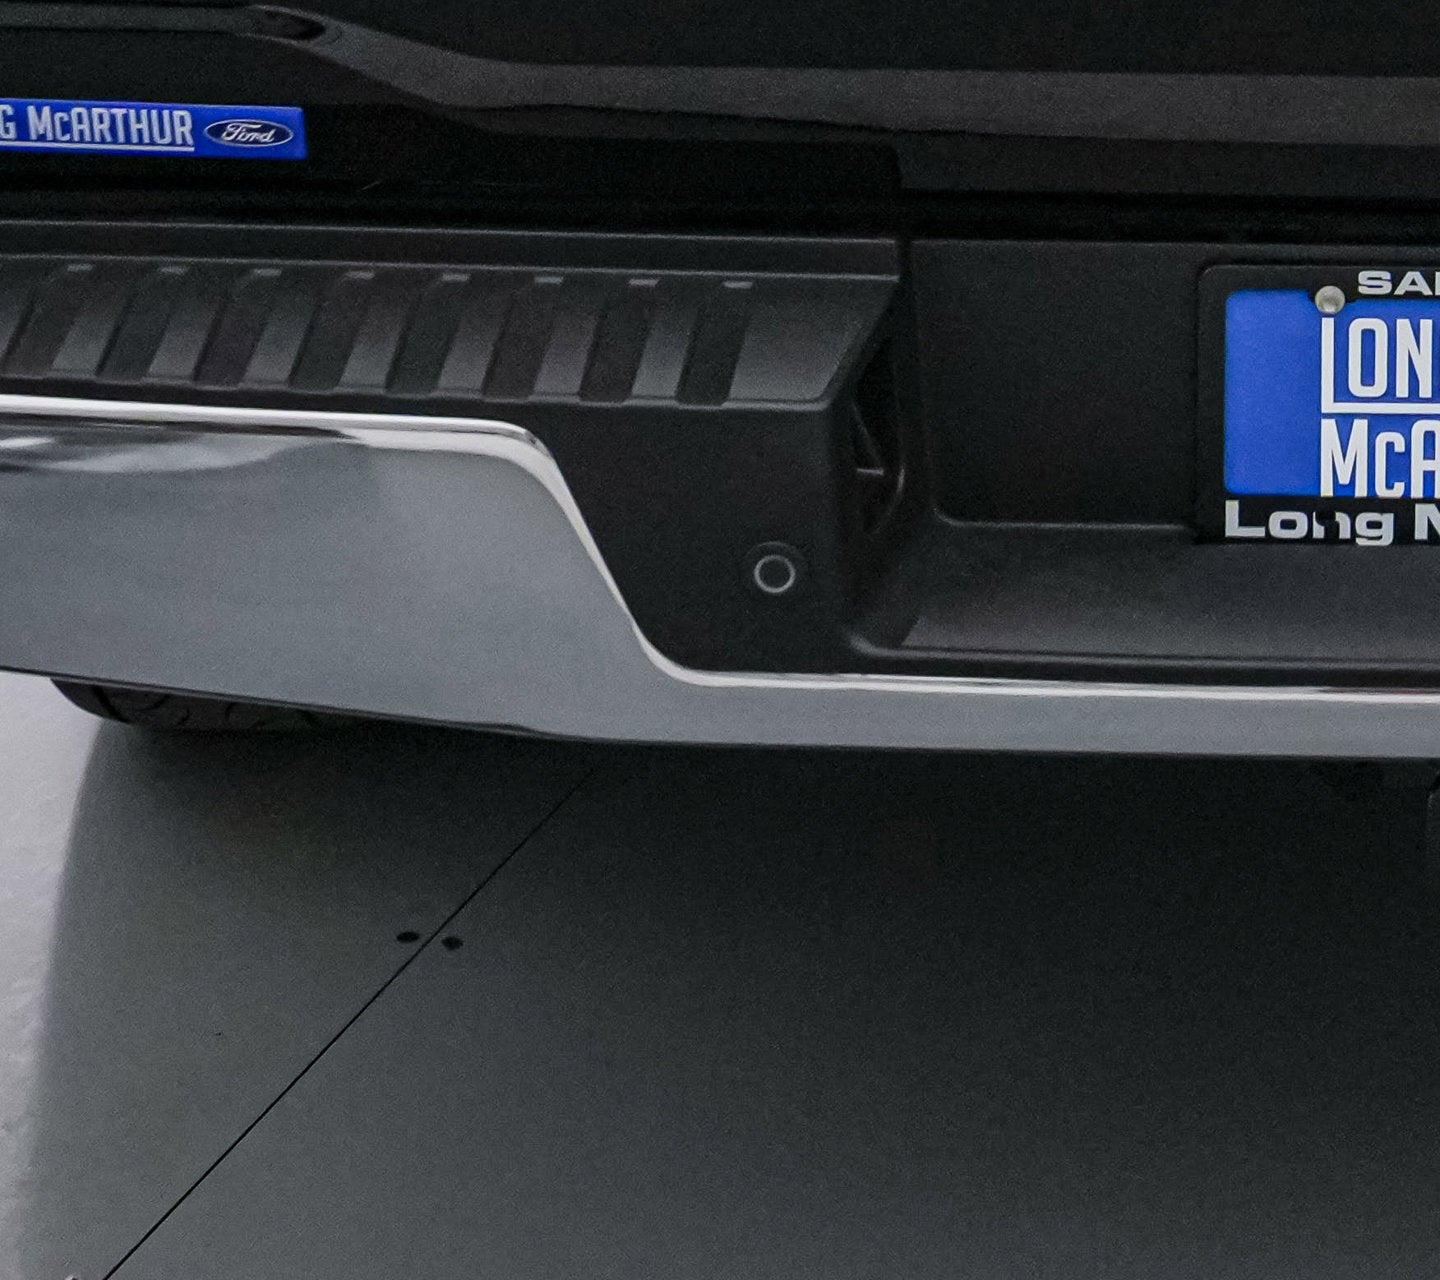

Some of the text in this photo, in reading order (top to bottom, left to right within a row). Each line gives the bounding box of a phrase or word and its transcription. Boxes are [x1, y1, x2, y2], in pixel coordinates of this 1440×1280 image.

[26, 104, 194, 146] McARTHUR
[220, 122, 277, 144] Ford
[1225, 500, 1395, 547] Long
